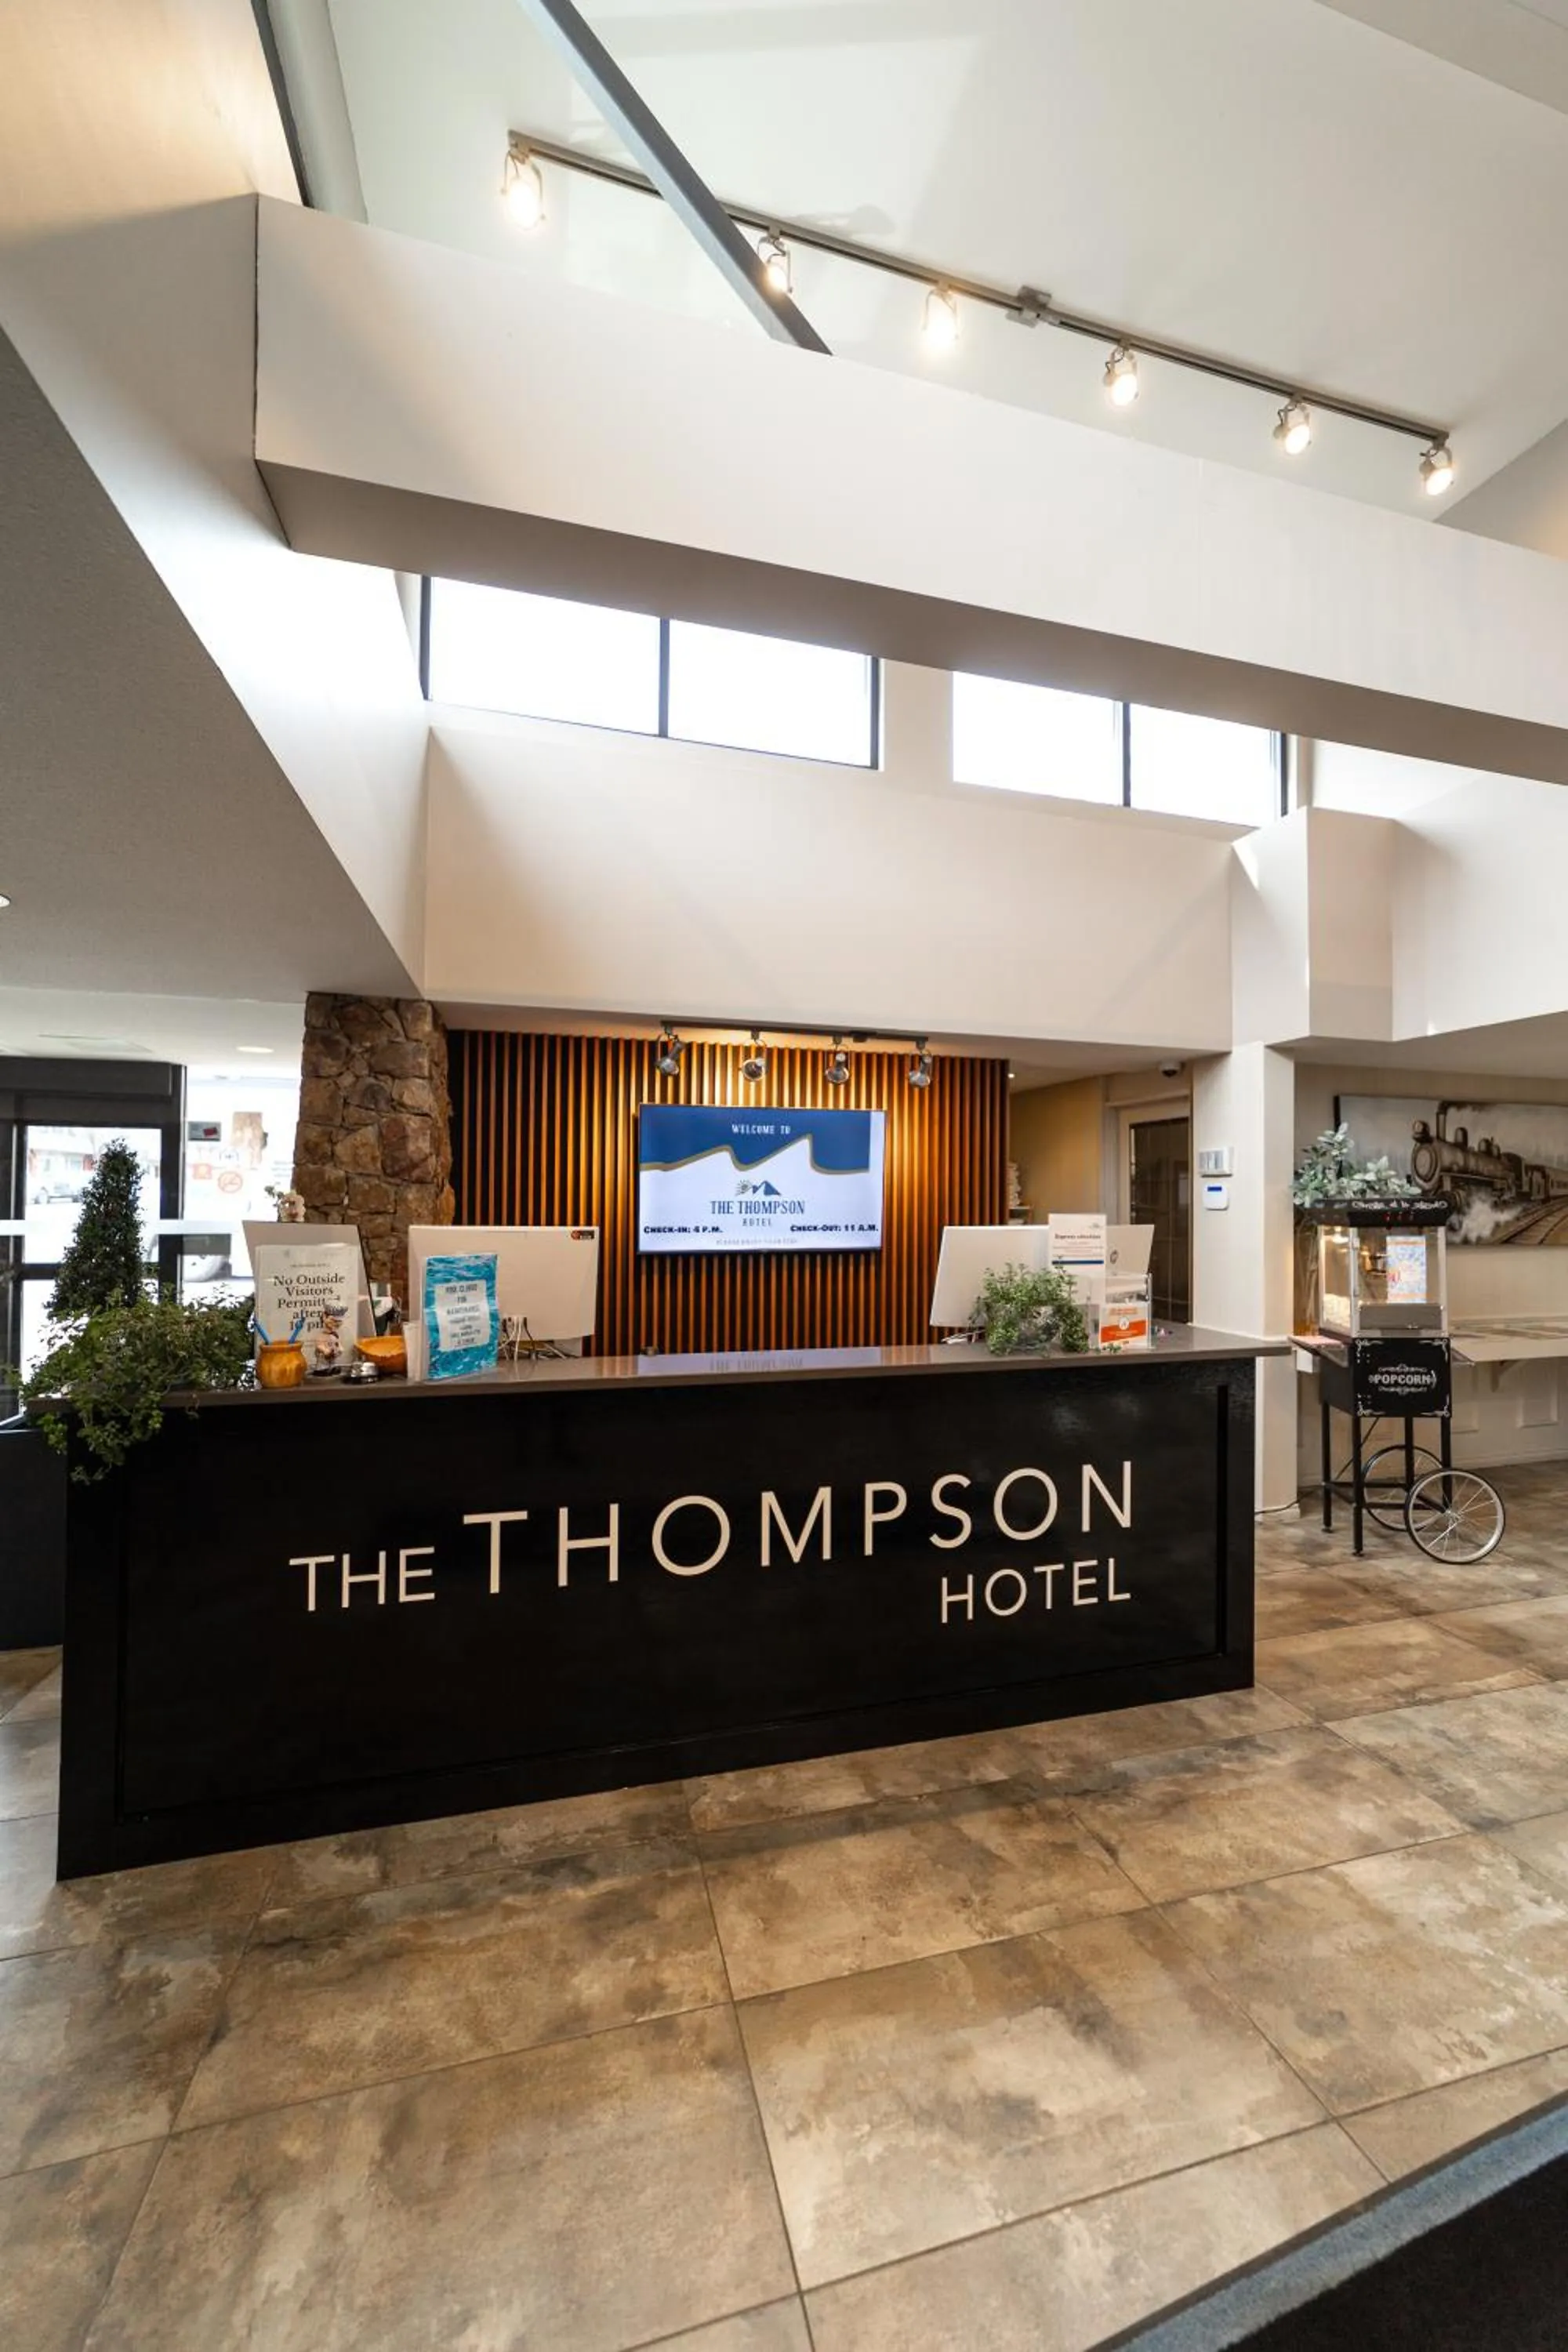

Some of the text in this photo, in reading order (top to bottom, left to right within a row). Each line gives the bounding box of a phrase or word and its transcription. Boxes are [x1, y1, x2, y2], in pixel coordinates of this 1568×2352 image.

[731, 1123, 791, 1134] WELCOME TO
[710, 1200, 805, 1214] THE THOMPSON
[742, 1218, 772, 1227] HOTEL
[274, 1273, 345, 1287] No Outside
[285, 1286, 333, 1296] Visitors
[1374, 1374, 1431, 1385] POPCORN
[289, 1461, 1131, 1611] THE THOMPSON
[942, 1558, 1131, 1624] HOTEL
